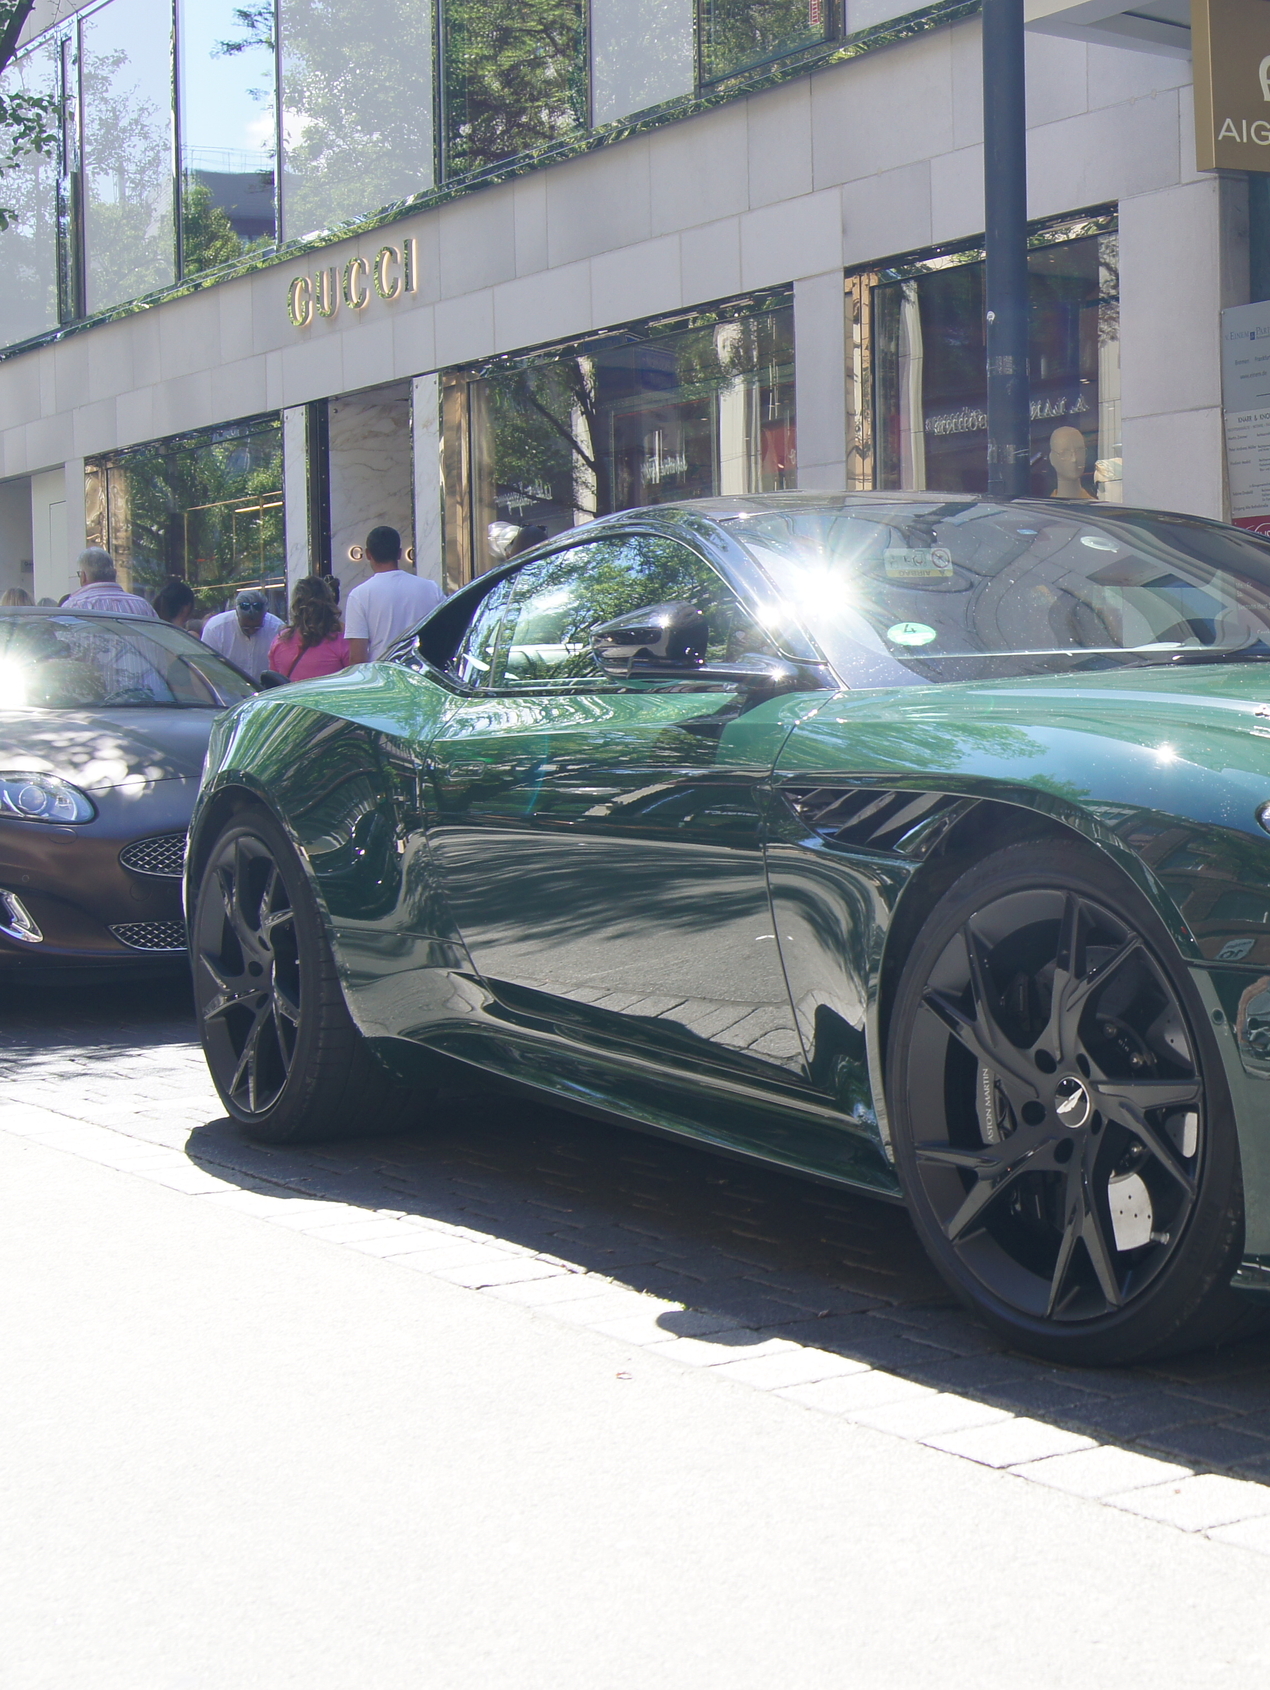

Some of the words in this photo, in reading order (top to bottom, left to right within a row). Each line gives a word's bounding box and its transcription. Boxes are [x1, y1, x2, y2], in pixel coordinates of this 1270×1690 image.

[287, 238, 417, 327] GUCCI
[982, 1068, 991, 1107] MARTIN
[986, 1108, 994, 1142] ASTON
